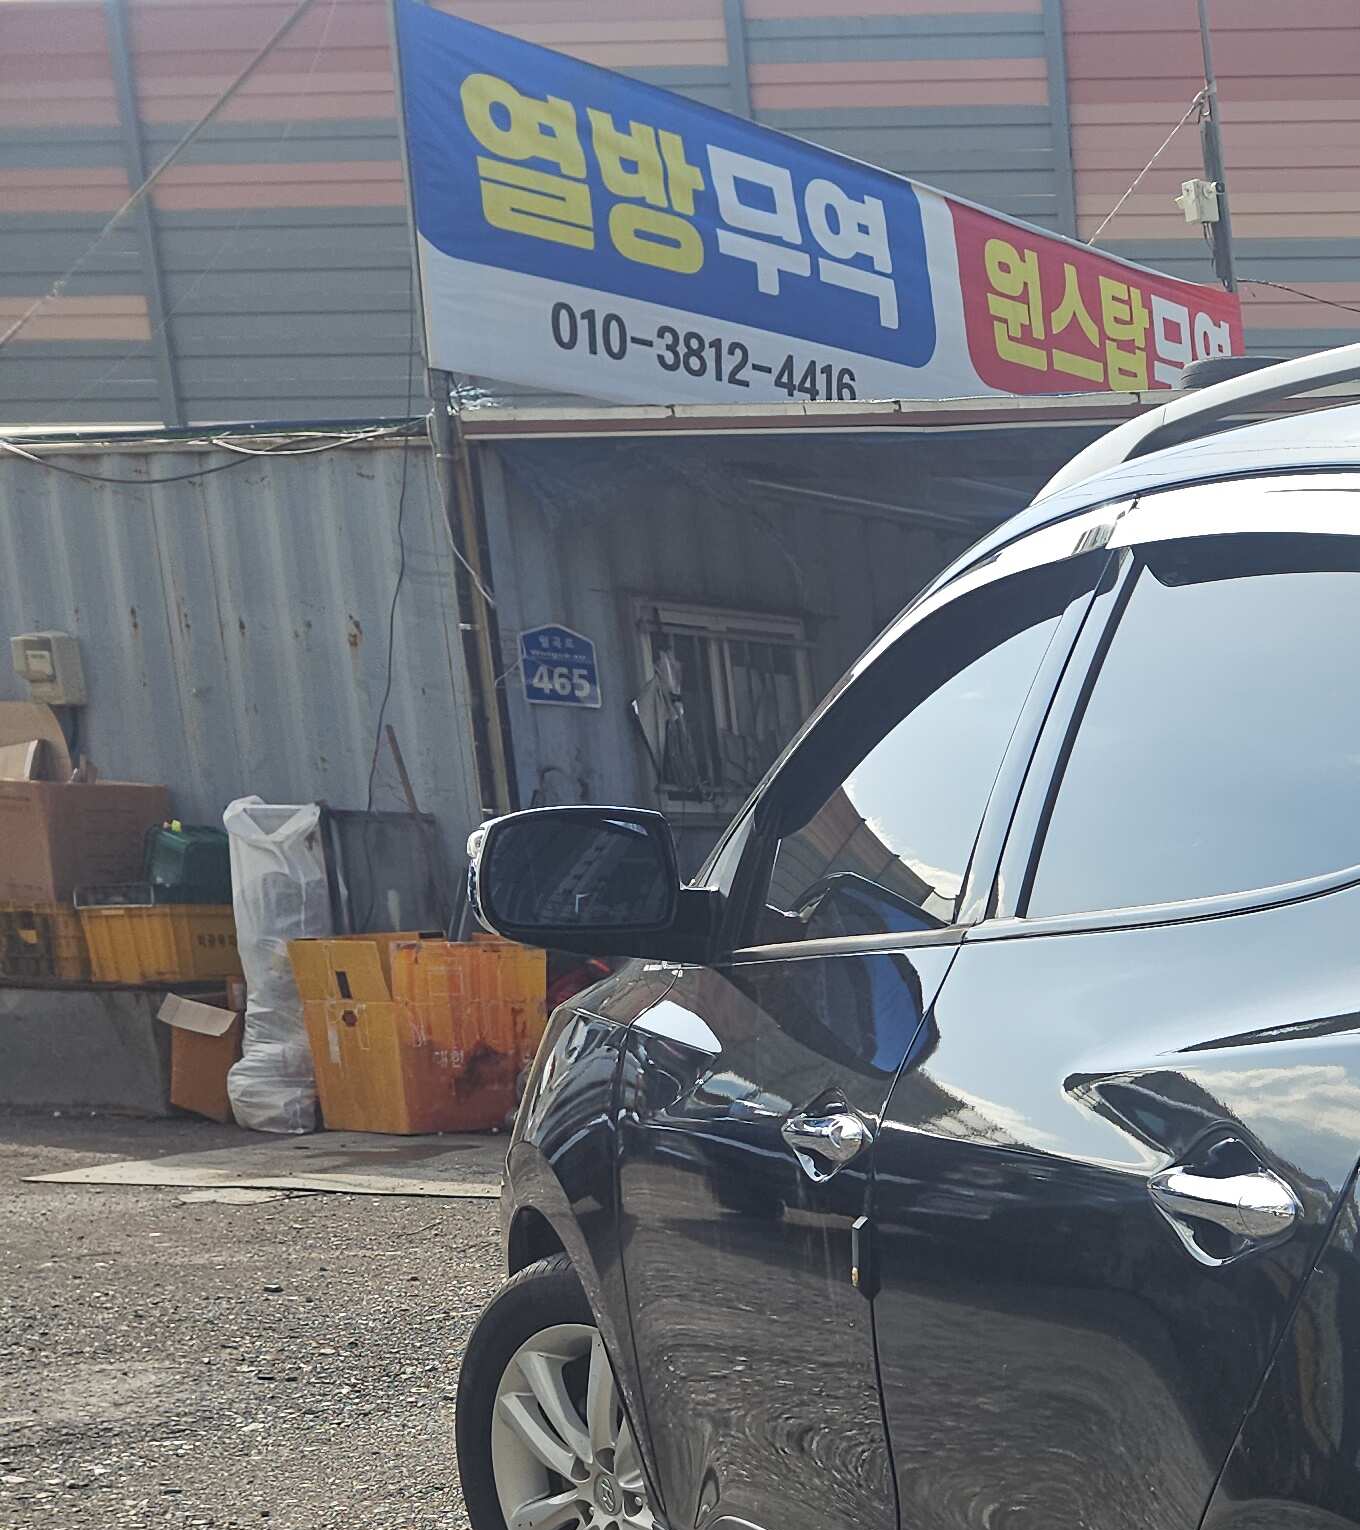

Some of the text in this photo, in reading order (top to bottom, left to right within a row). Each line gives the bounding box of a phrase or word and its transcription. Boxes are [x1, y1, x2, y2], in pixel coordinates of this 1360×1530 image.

[460, 73, 899, 329] 열방무역
[551, 301, 857, 400] 010-3812-4416
[532, 664, 591, 698] 465
